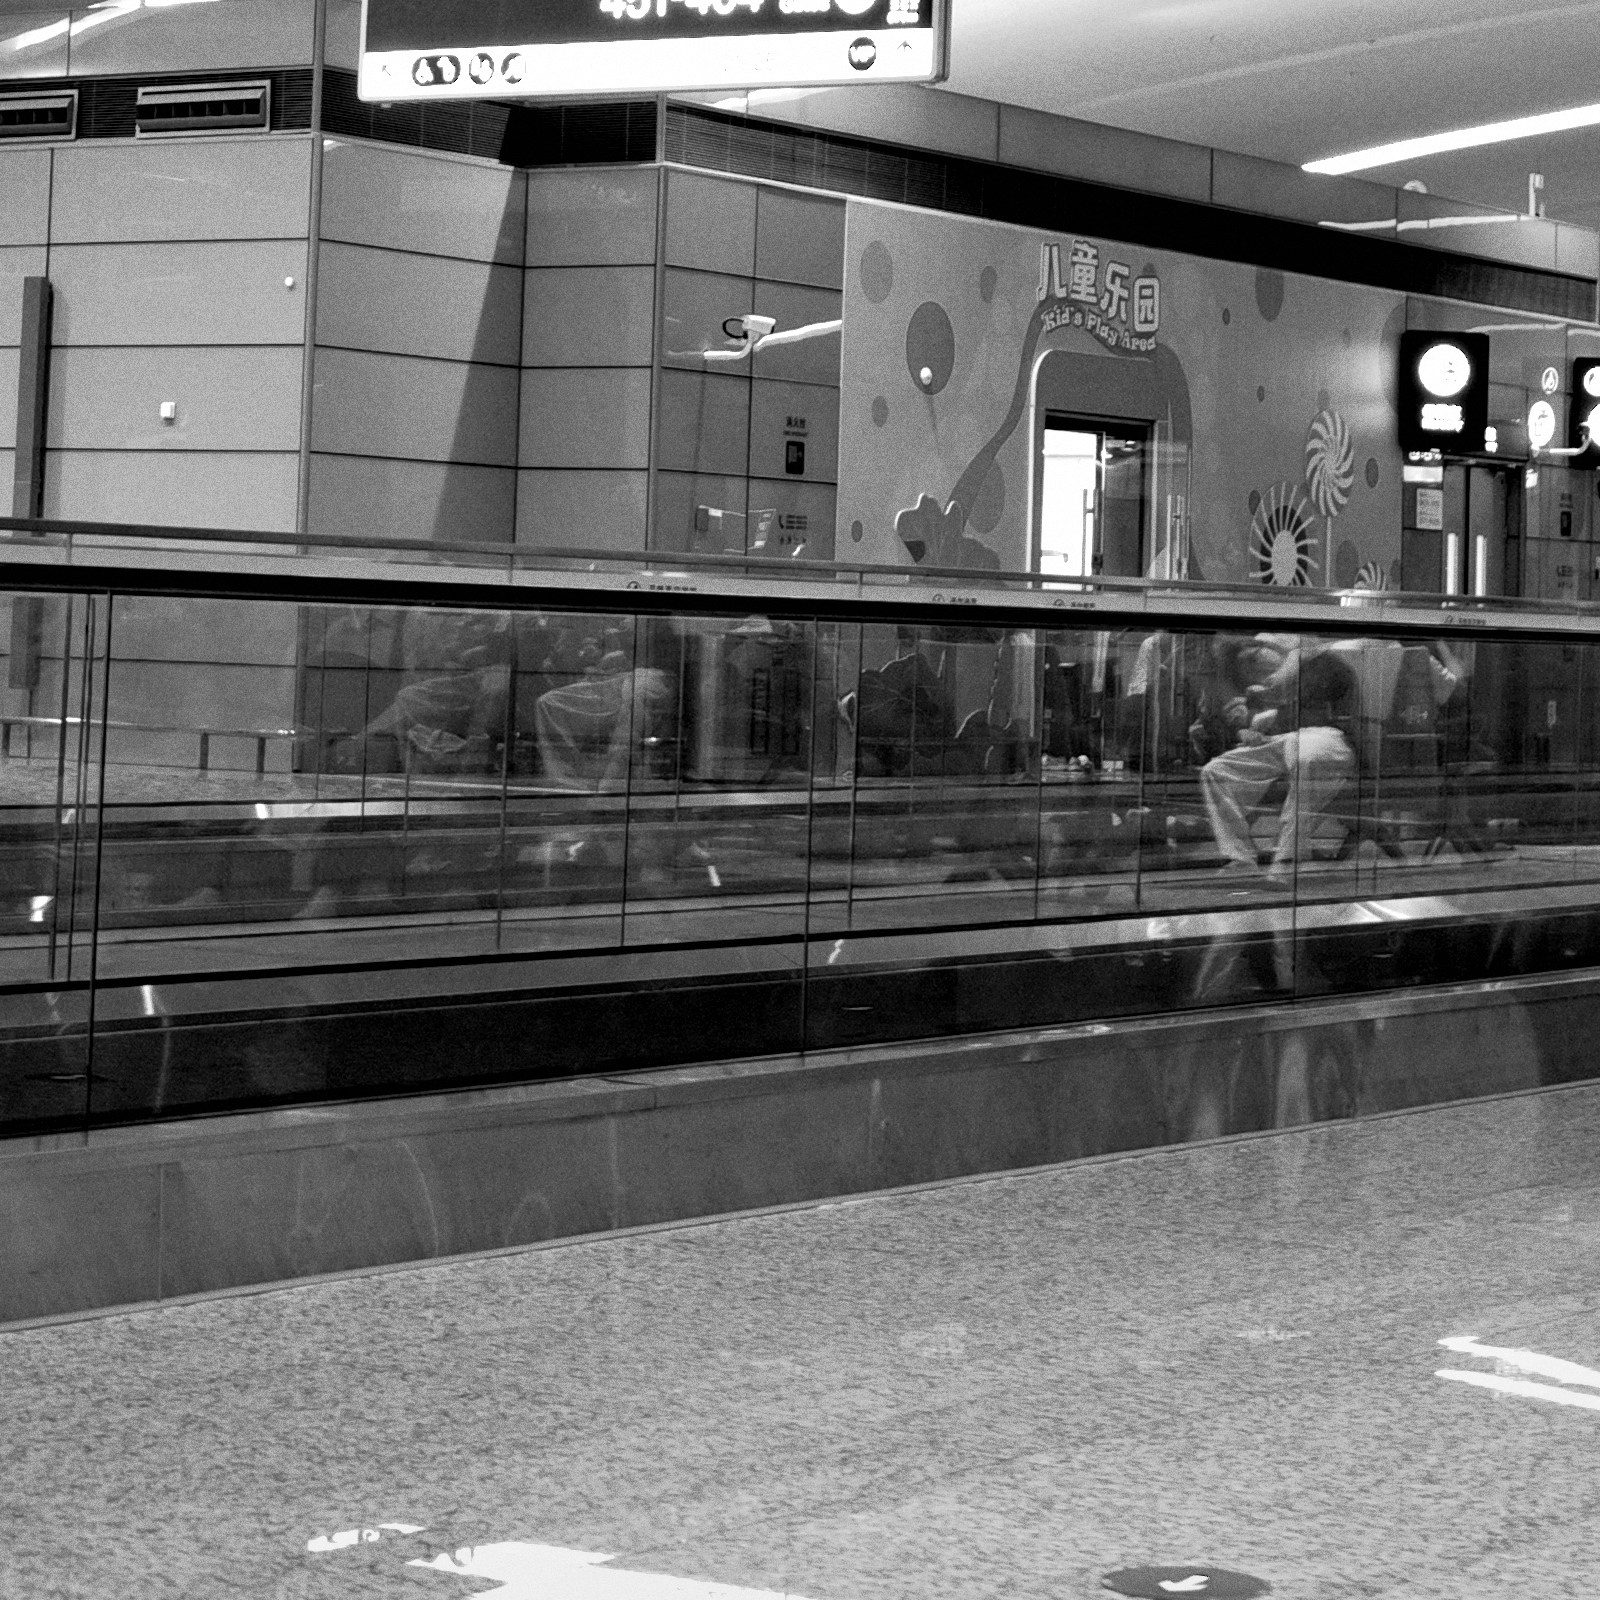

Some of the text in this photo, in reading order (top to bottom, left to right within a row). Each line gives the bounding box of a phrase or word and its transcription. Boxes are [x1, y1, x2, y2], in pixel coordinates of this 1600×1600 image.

[1036, 239, 1160, 331] 儿童乐园
[1041, 304, 1158, 352] Kid's Play Area
